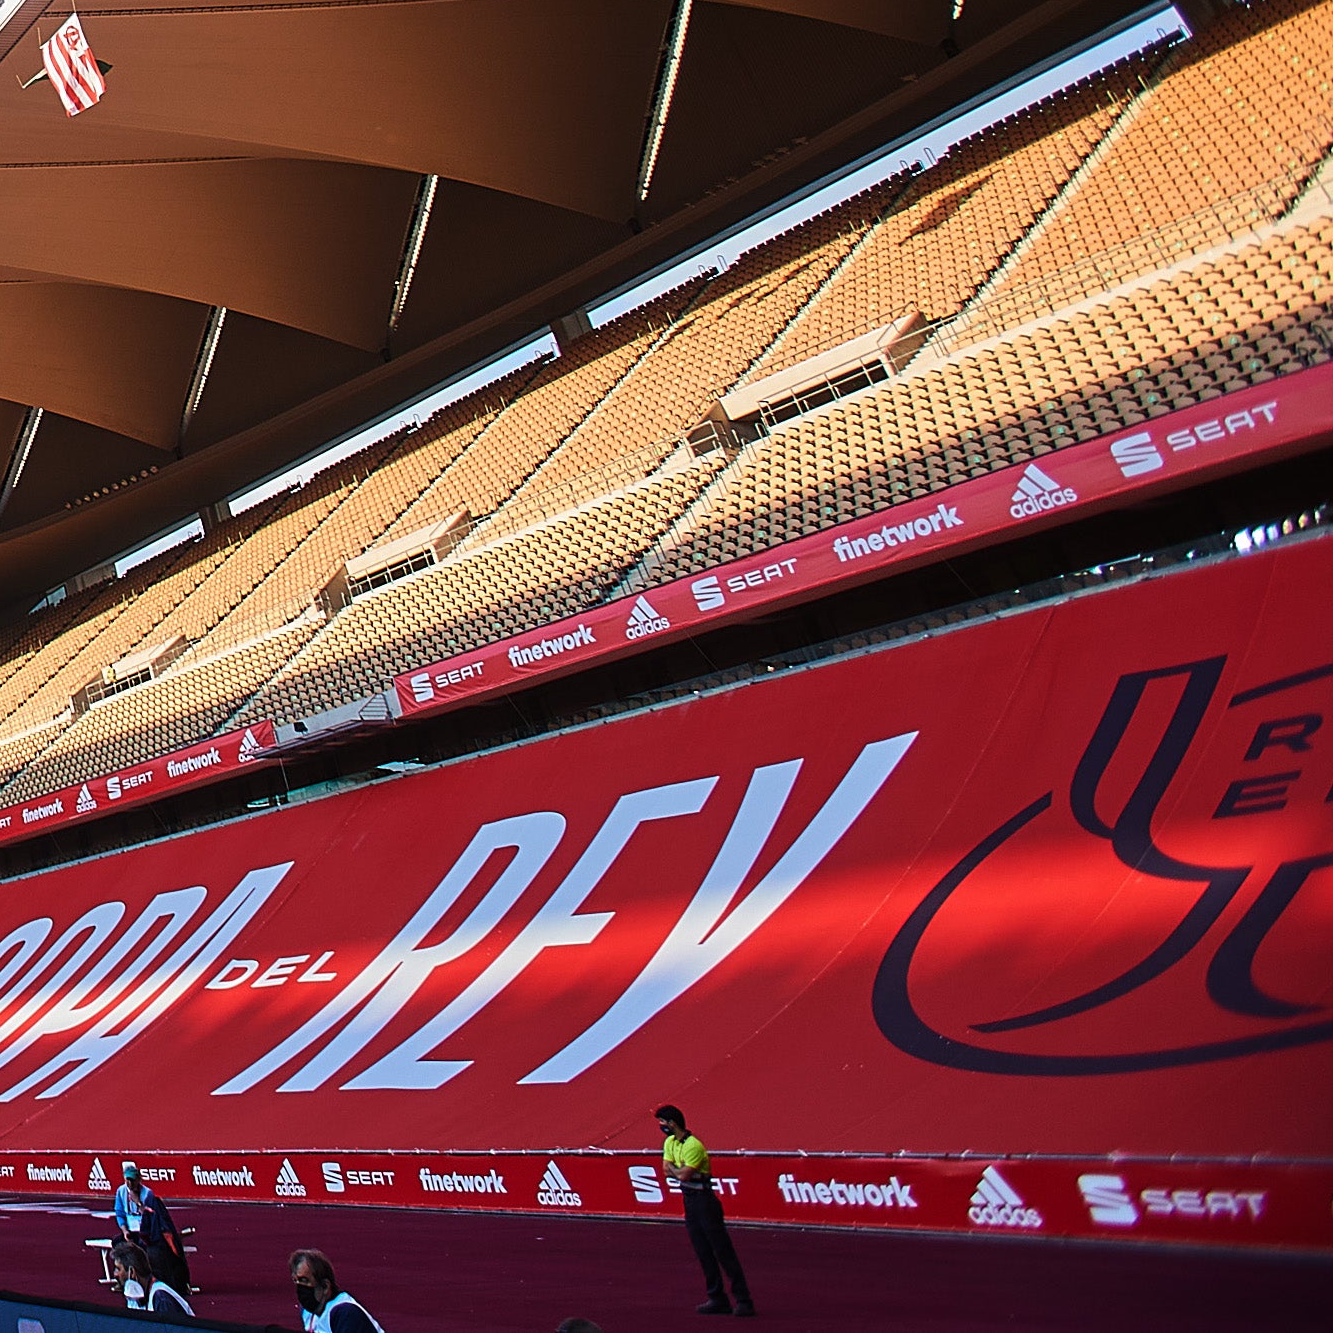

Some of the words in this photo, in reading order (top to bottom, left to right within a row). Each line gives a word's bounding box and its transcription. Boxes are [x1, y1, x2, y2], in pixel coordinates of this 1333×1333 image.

[1166, 401, 1277, 452] SEAT
[1009, 486, 1078, 520] adidas
[833, 503, 965, 563] finetwork
[730, 558, 798, 594] SEAT
[625, 617, 671, 641] adidas
[508, 623, 597, 667] finetwork
[434, 660, 485, 689] SEAT
[167, 747, 222, 778] finetwork
[121, 770, 153, 790] SEAT
[22, 798, 64, 824] finetwork
[76, 800, 97, 814] adidas
[210, 729, 920, 1096] REY
[204, 951, 339, 991] DEL
[27, 1163, 74, 1182] finetwork
[88, 1177, 112, 1191] adidas
[139, 1167, 176, 1181] SEAT
[192, 1166, 255, 1187] finetwork
[346, 1171, 395, 1186] SEAT
[419, 1168, 508, 1194] finetwork
[275, 1182, 307, 1197] adidas
[537, 1189, 583, 1207] adidas
[665, 1177, 739, 1195] SAT
[778, 1173, 918, 1209] finetwork
[967, 1204, 1043, 1228] adidas
[1139, 1189, 1268, 1224] SEAT
